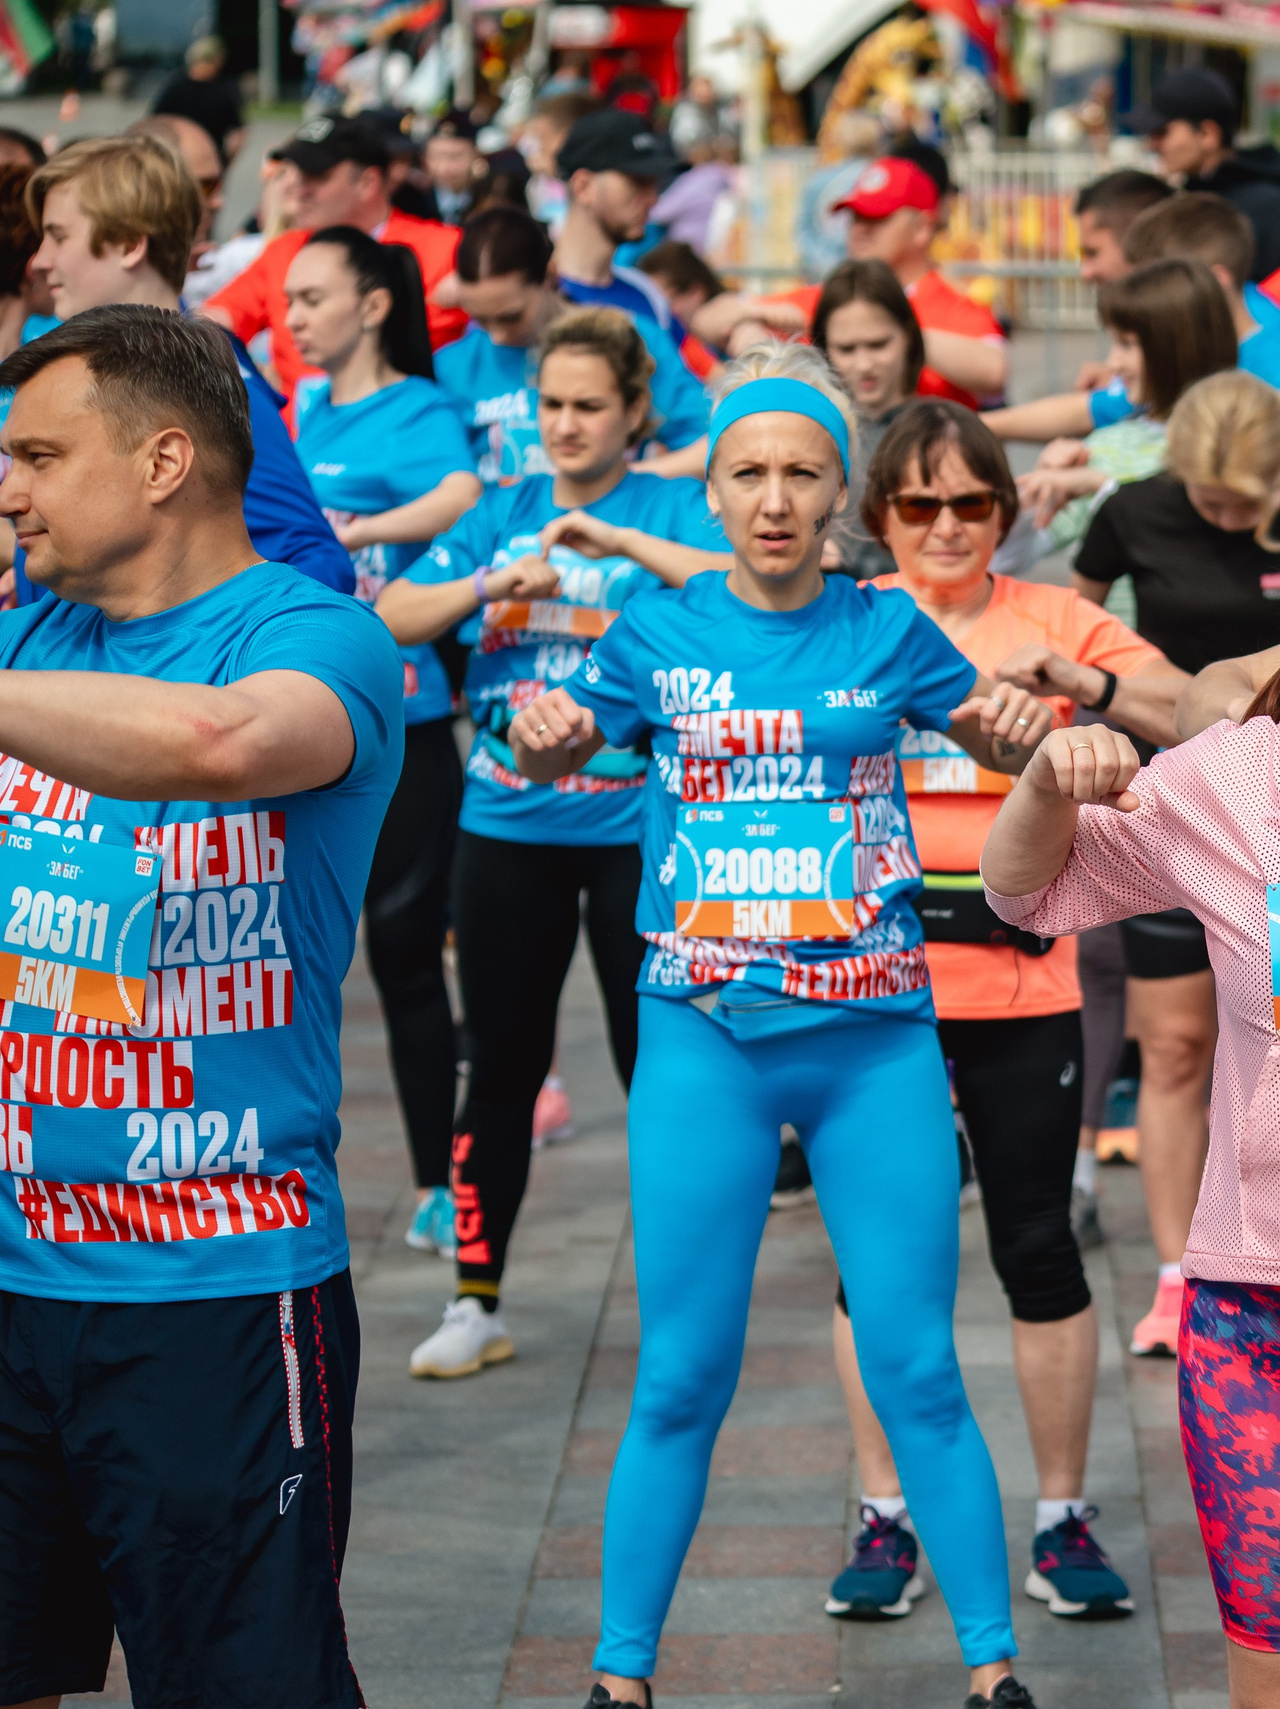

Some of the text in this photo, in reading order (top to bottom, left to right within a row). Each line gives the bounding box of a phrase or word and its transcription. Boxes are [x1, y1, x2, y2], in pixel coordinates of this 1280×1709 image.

[652, 667, 735, 715] 2024
[923, 758, 976, 793] 5KM
[8, 834, 32, 851] ПСБ
[137, 858, 152, 867] FON
[136, 865, 151, 874] BET
[704, 847, 822, 894] 20088
[4, 885, 110, 962] 20311
[733, 900, 791, 937] 5KM
[14, 955, 77, 1014] 5KM
[54, 957, 294, 1039] ОМЕНТ
[0, 1031, 194, 1109] РДОСТЬ
[127, 1108, 264, 1181] 2024
[18, 1169, 310, 1242] #ЕДИНСТВО
